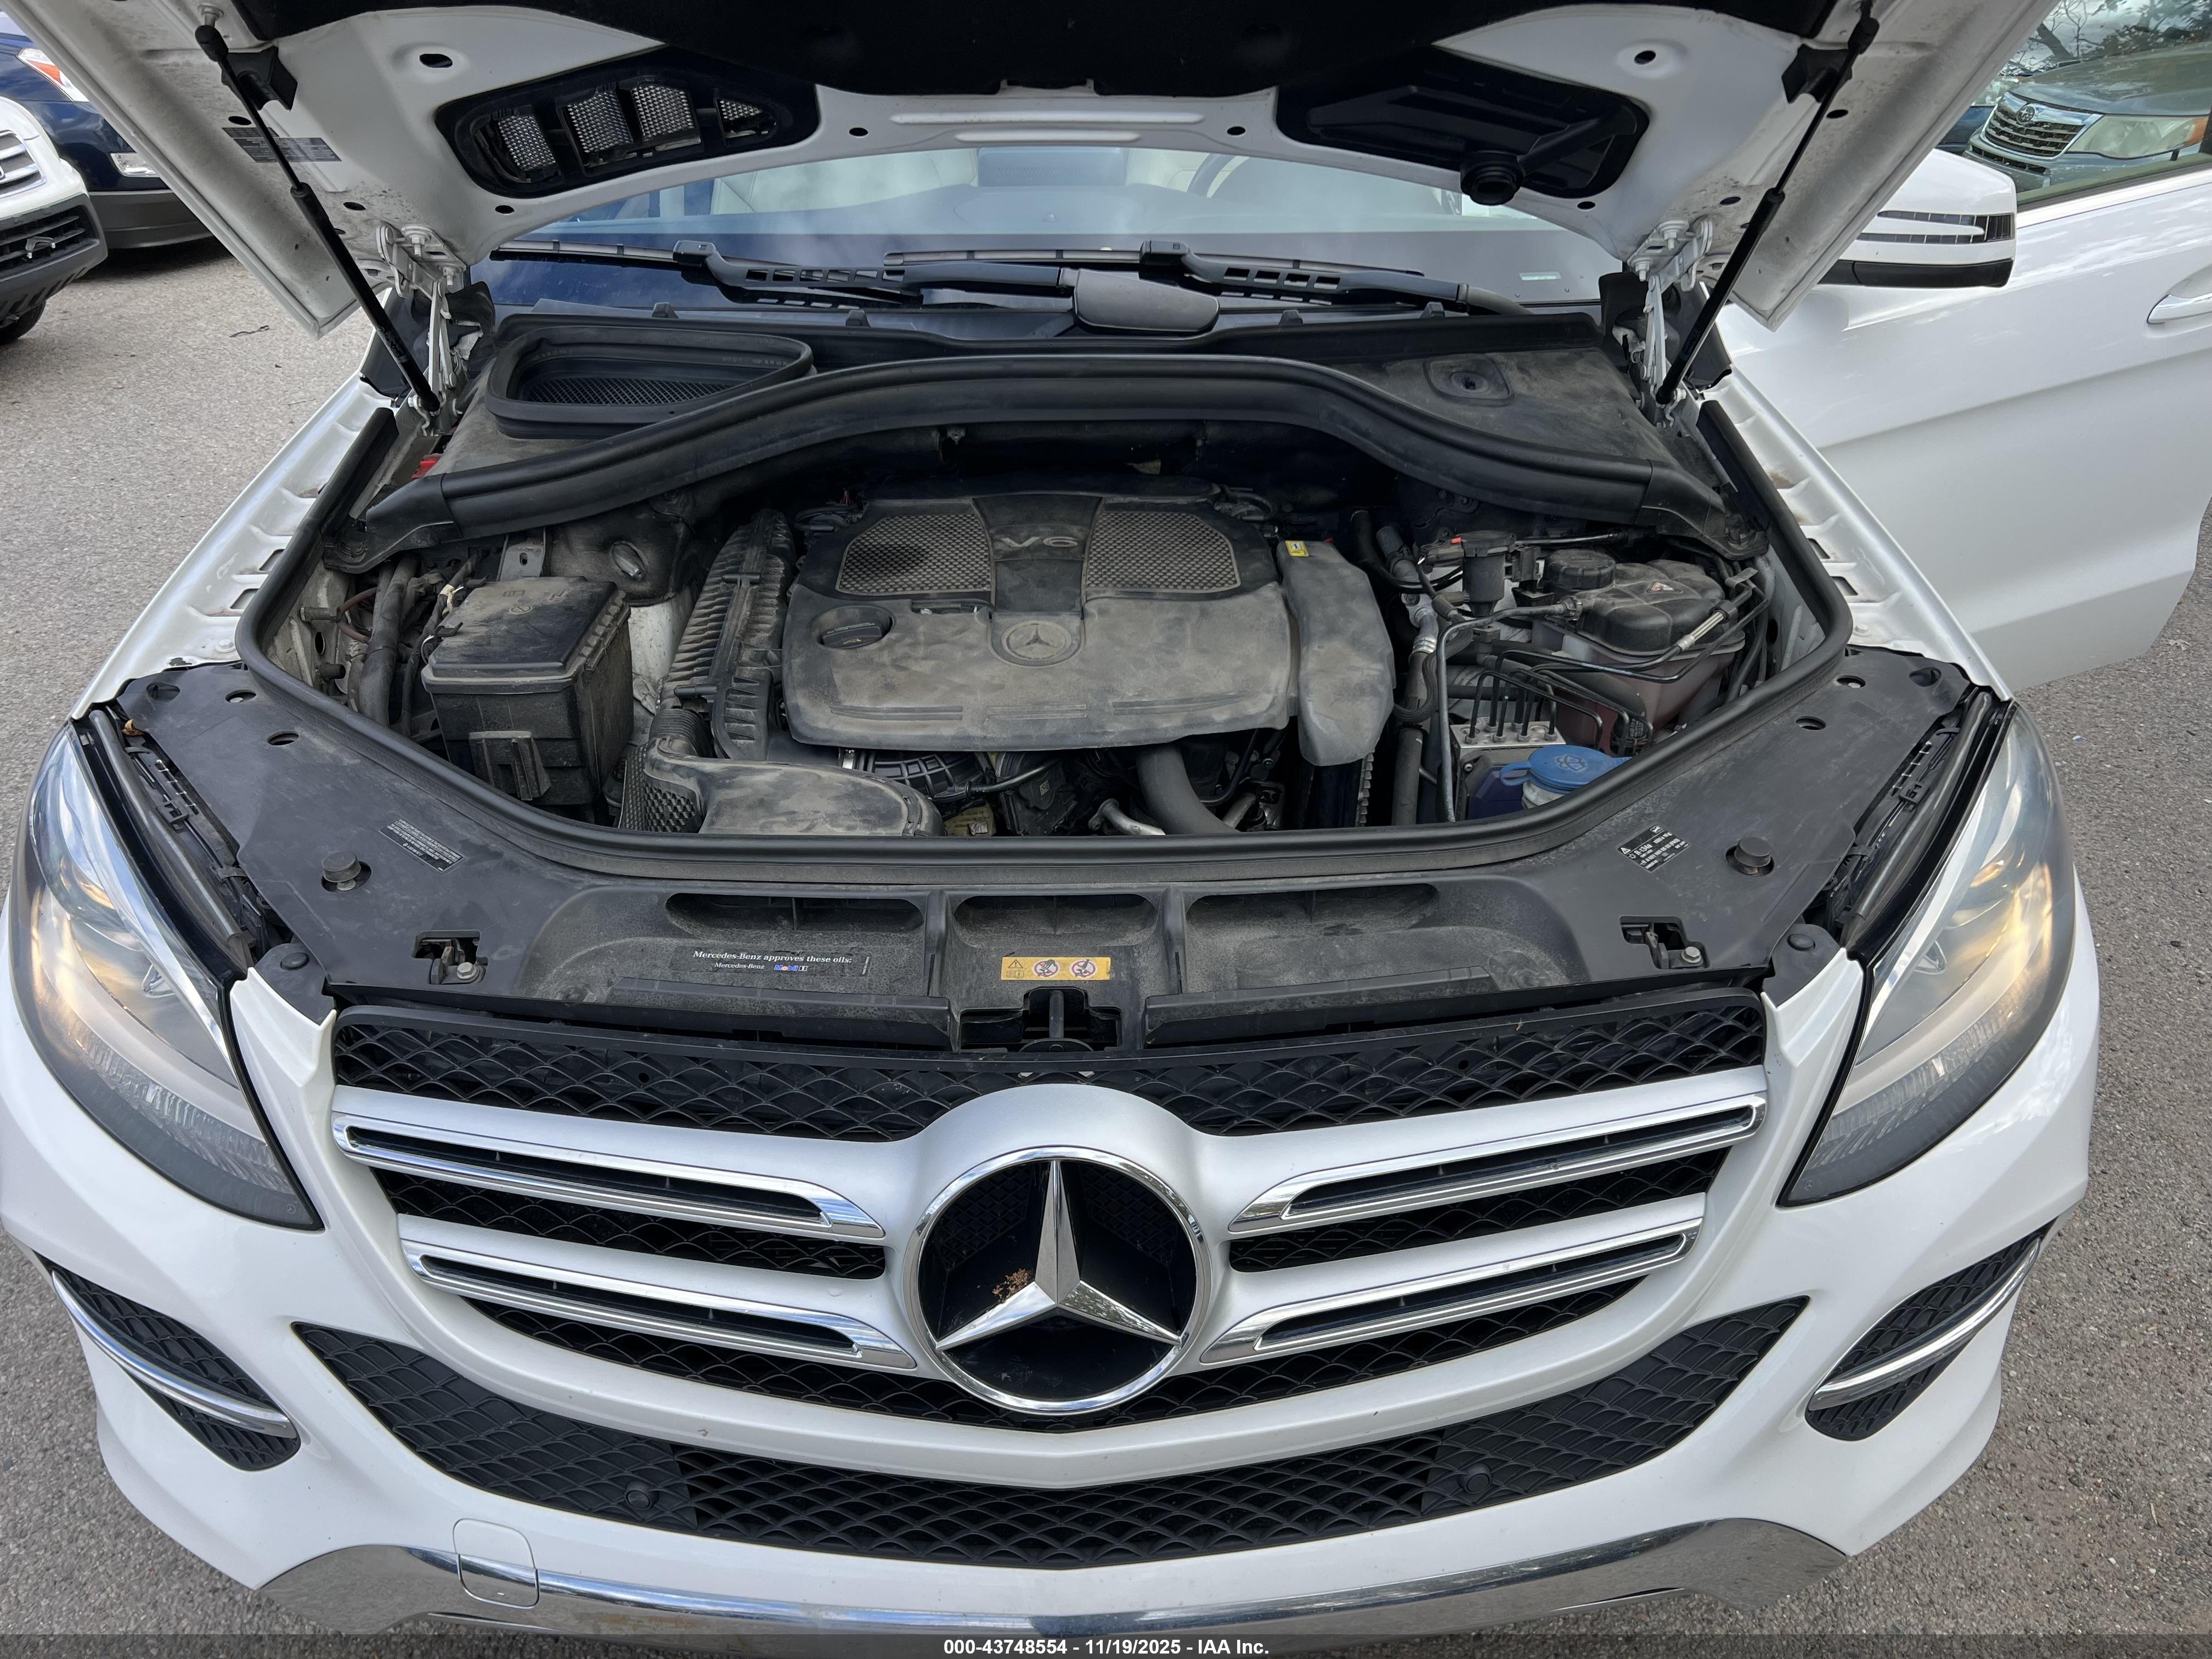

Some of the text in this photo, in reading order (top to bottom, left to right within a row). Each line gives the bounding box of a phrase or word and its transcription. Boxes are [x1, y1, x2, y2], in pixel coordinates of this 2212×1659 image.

[996, 535, 1079, 548] V6
[692, 950, 761, 960] Mercedes-Benz
[763, 955, 805, 963] approves
